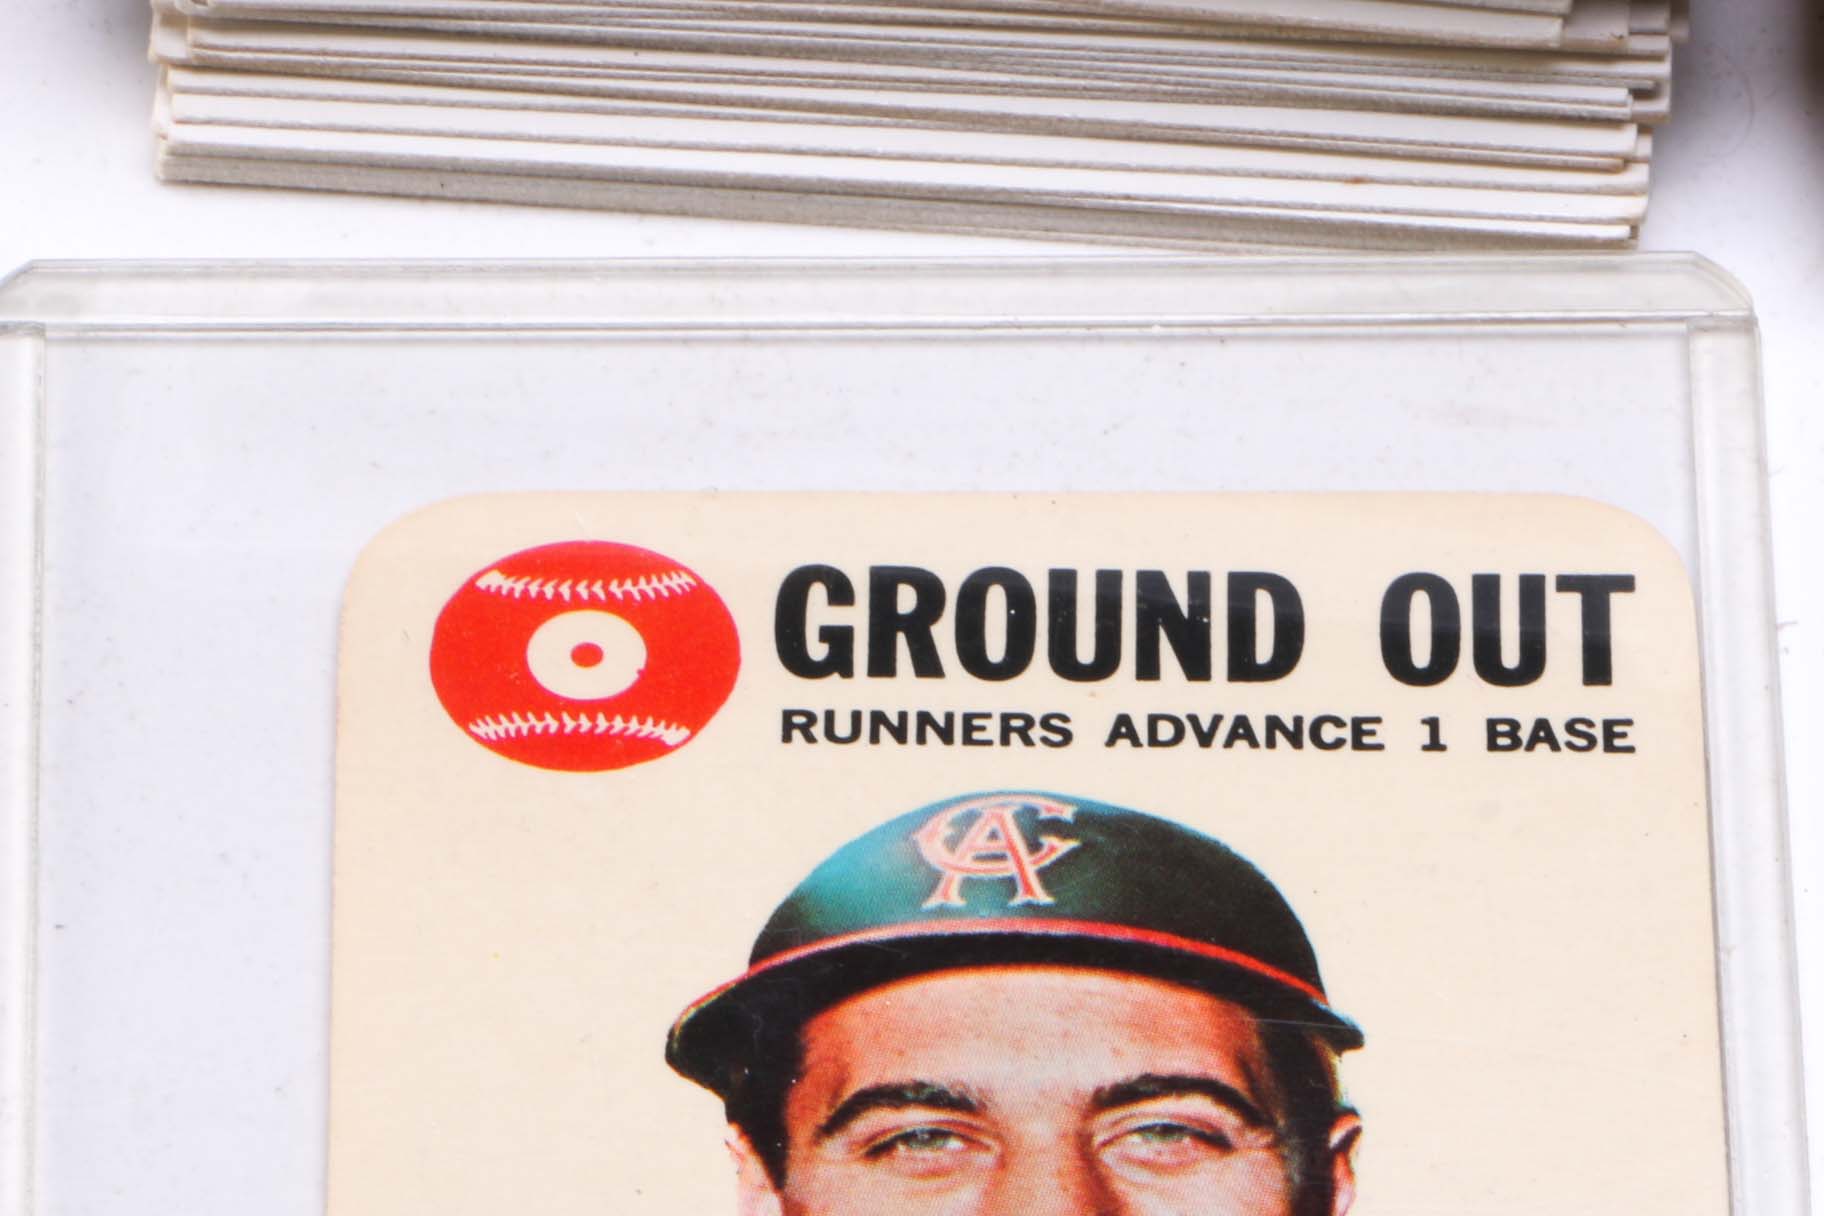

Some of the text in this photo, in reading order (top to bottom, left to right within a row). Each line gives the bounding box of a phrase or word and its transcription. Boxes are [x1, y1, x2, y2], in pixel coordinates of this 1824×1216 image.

[775, 566, 1634, 686] GROUND OUT
[783, 710, 1635, 752] RUNNERS ADVANCE 1 BASE
